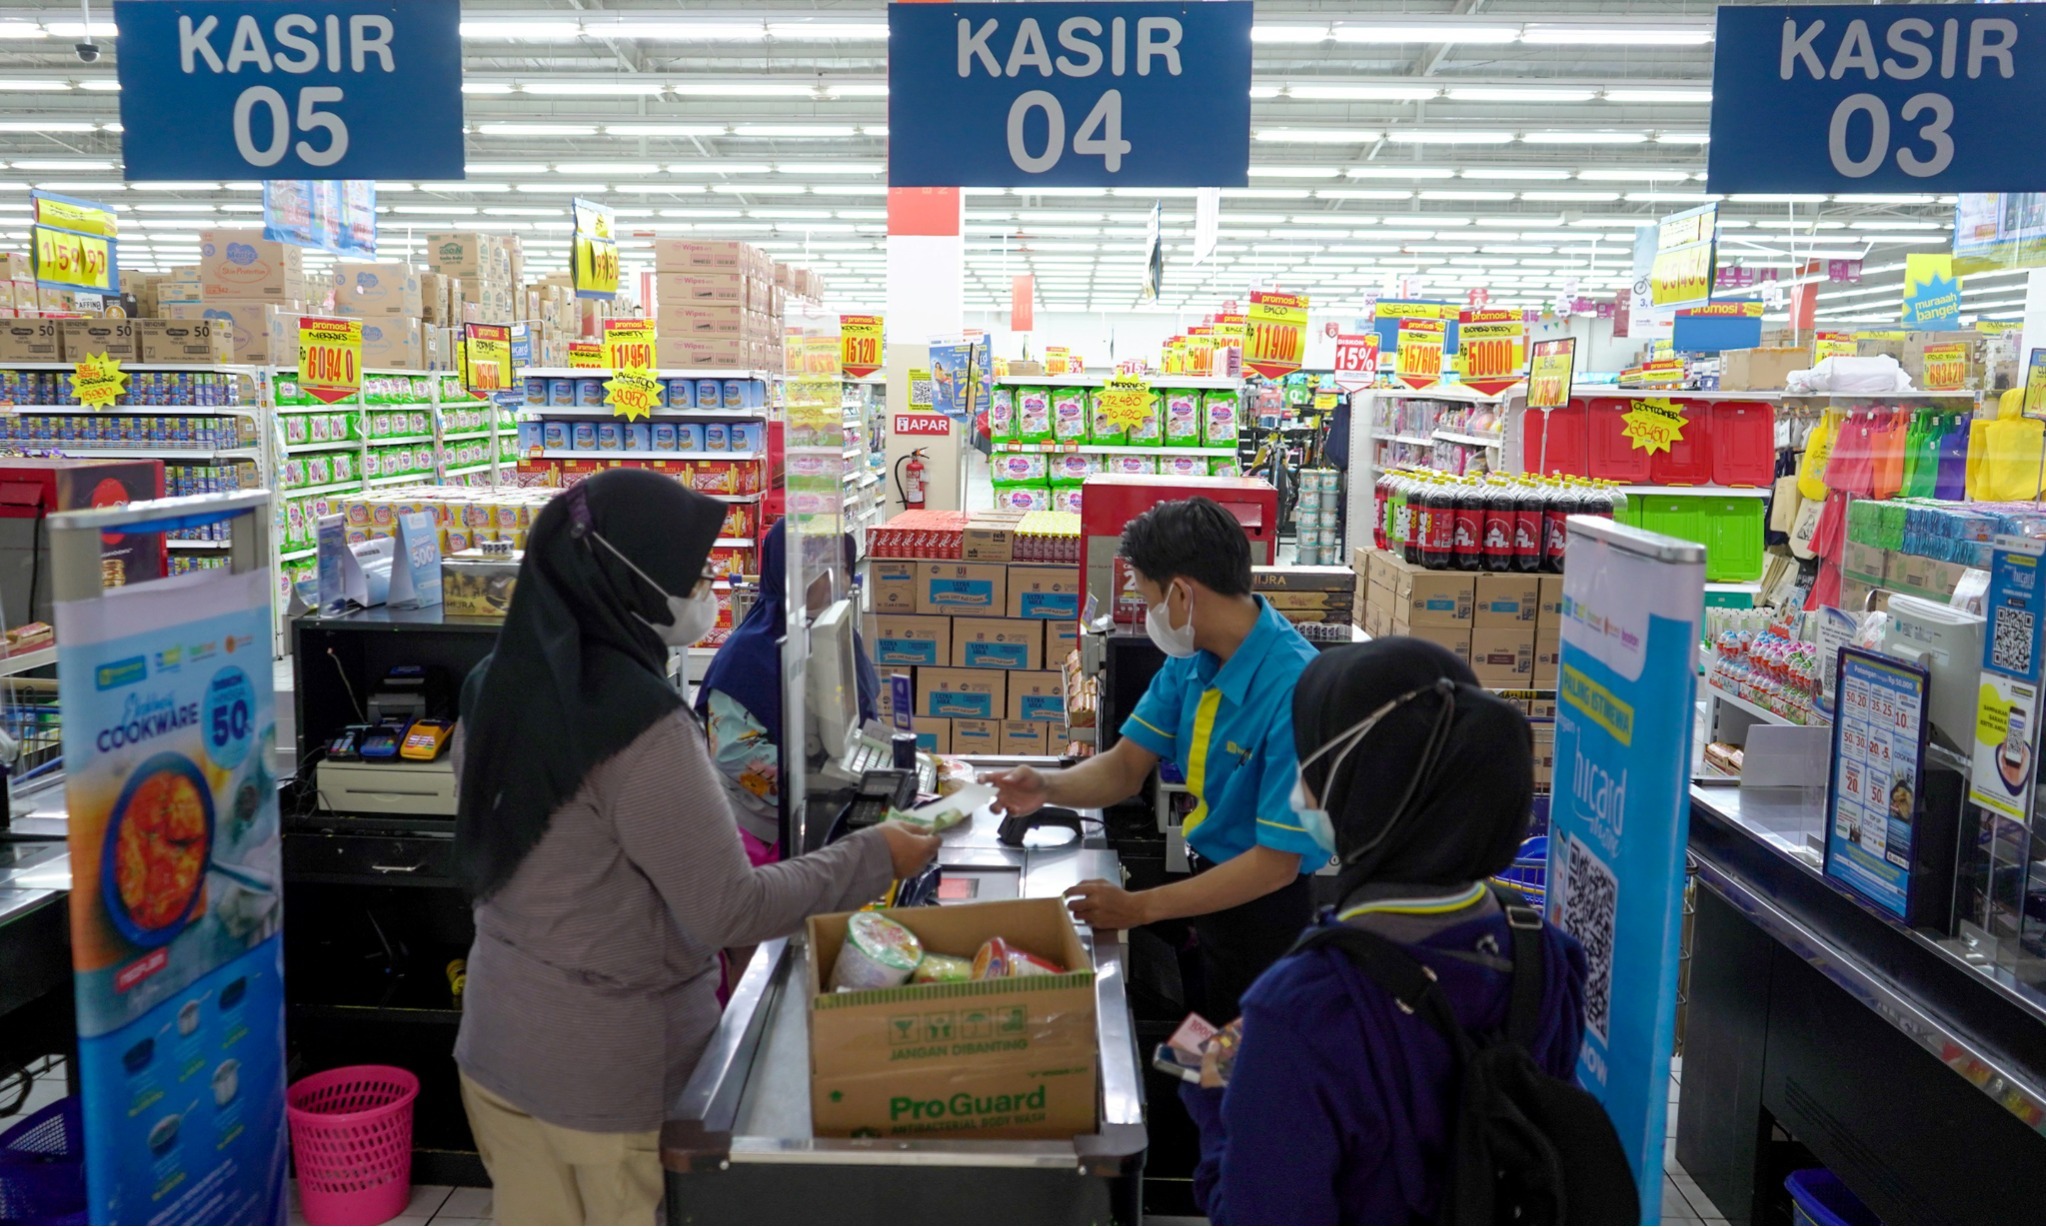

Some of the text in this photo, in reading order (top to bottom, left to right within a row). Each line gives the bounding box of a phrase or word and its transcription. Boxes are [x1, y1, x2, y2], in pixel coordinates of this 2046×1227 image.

[178, 14, 395, 75] KASIR
[957, 15, 1184, 79] KASIR
[1779, 17, 2019, 81] KASIR
[233, 85, 350, 168] 05
[1006, 88, 1132, 174] 04
[1829, 92, 1955, 178] 03
[682, 243, 705, 251] Wipes
[684, 276, 706, 285] Wipes
[1261, 293, 1295, 305] promosi
[1915, 292, 1958, 310] muraaah
[1471, 312, 1508, 322] promosi
[1690, 303, 1738, 316] promosi
[1916, 303, 1960, 324] banget
[38, 325, 55, 336] 50
[116, 325, 133, 336] 50
[193, 326, 210, 337] 50
[312, 322, 347, 332] promosi
[615, 321, 643, 330] promosi
[308, 332, 348, 341] MERRIES
[684, 342, 706, 350] Wipes
[1254, 323, 1298, 362] 11900
[610, 344, 651, 369] 114950
[845, 337, 876, 364] 15120
[1336, 347, 1374, 371] 15%
[1404, 345, 1441, 374] 157605
[1468, 339, 1513, 377] 50000
[308, 346, 354, 383] 60940
[1650, 362, 1674, 370] promosi
[1110, 381, 1147, 391] MERRIES
[909, 419, 948, 431] APAR
[97, 702, 200, 753] COOKWARE
[212, 699, 248, 747] 50
[1895, 711, 1907, 728] 10
[1573, 726, 1628, 836] hicard
[890, 1038, 1028, 1061] JANGAN DIBANTING
[1014, 1112, 1046, 1125] WASH
